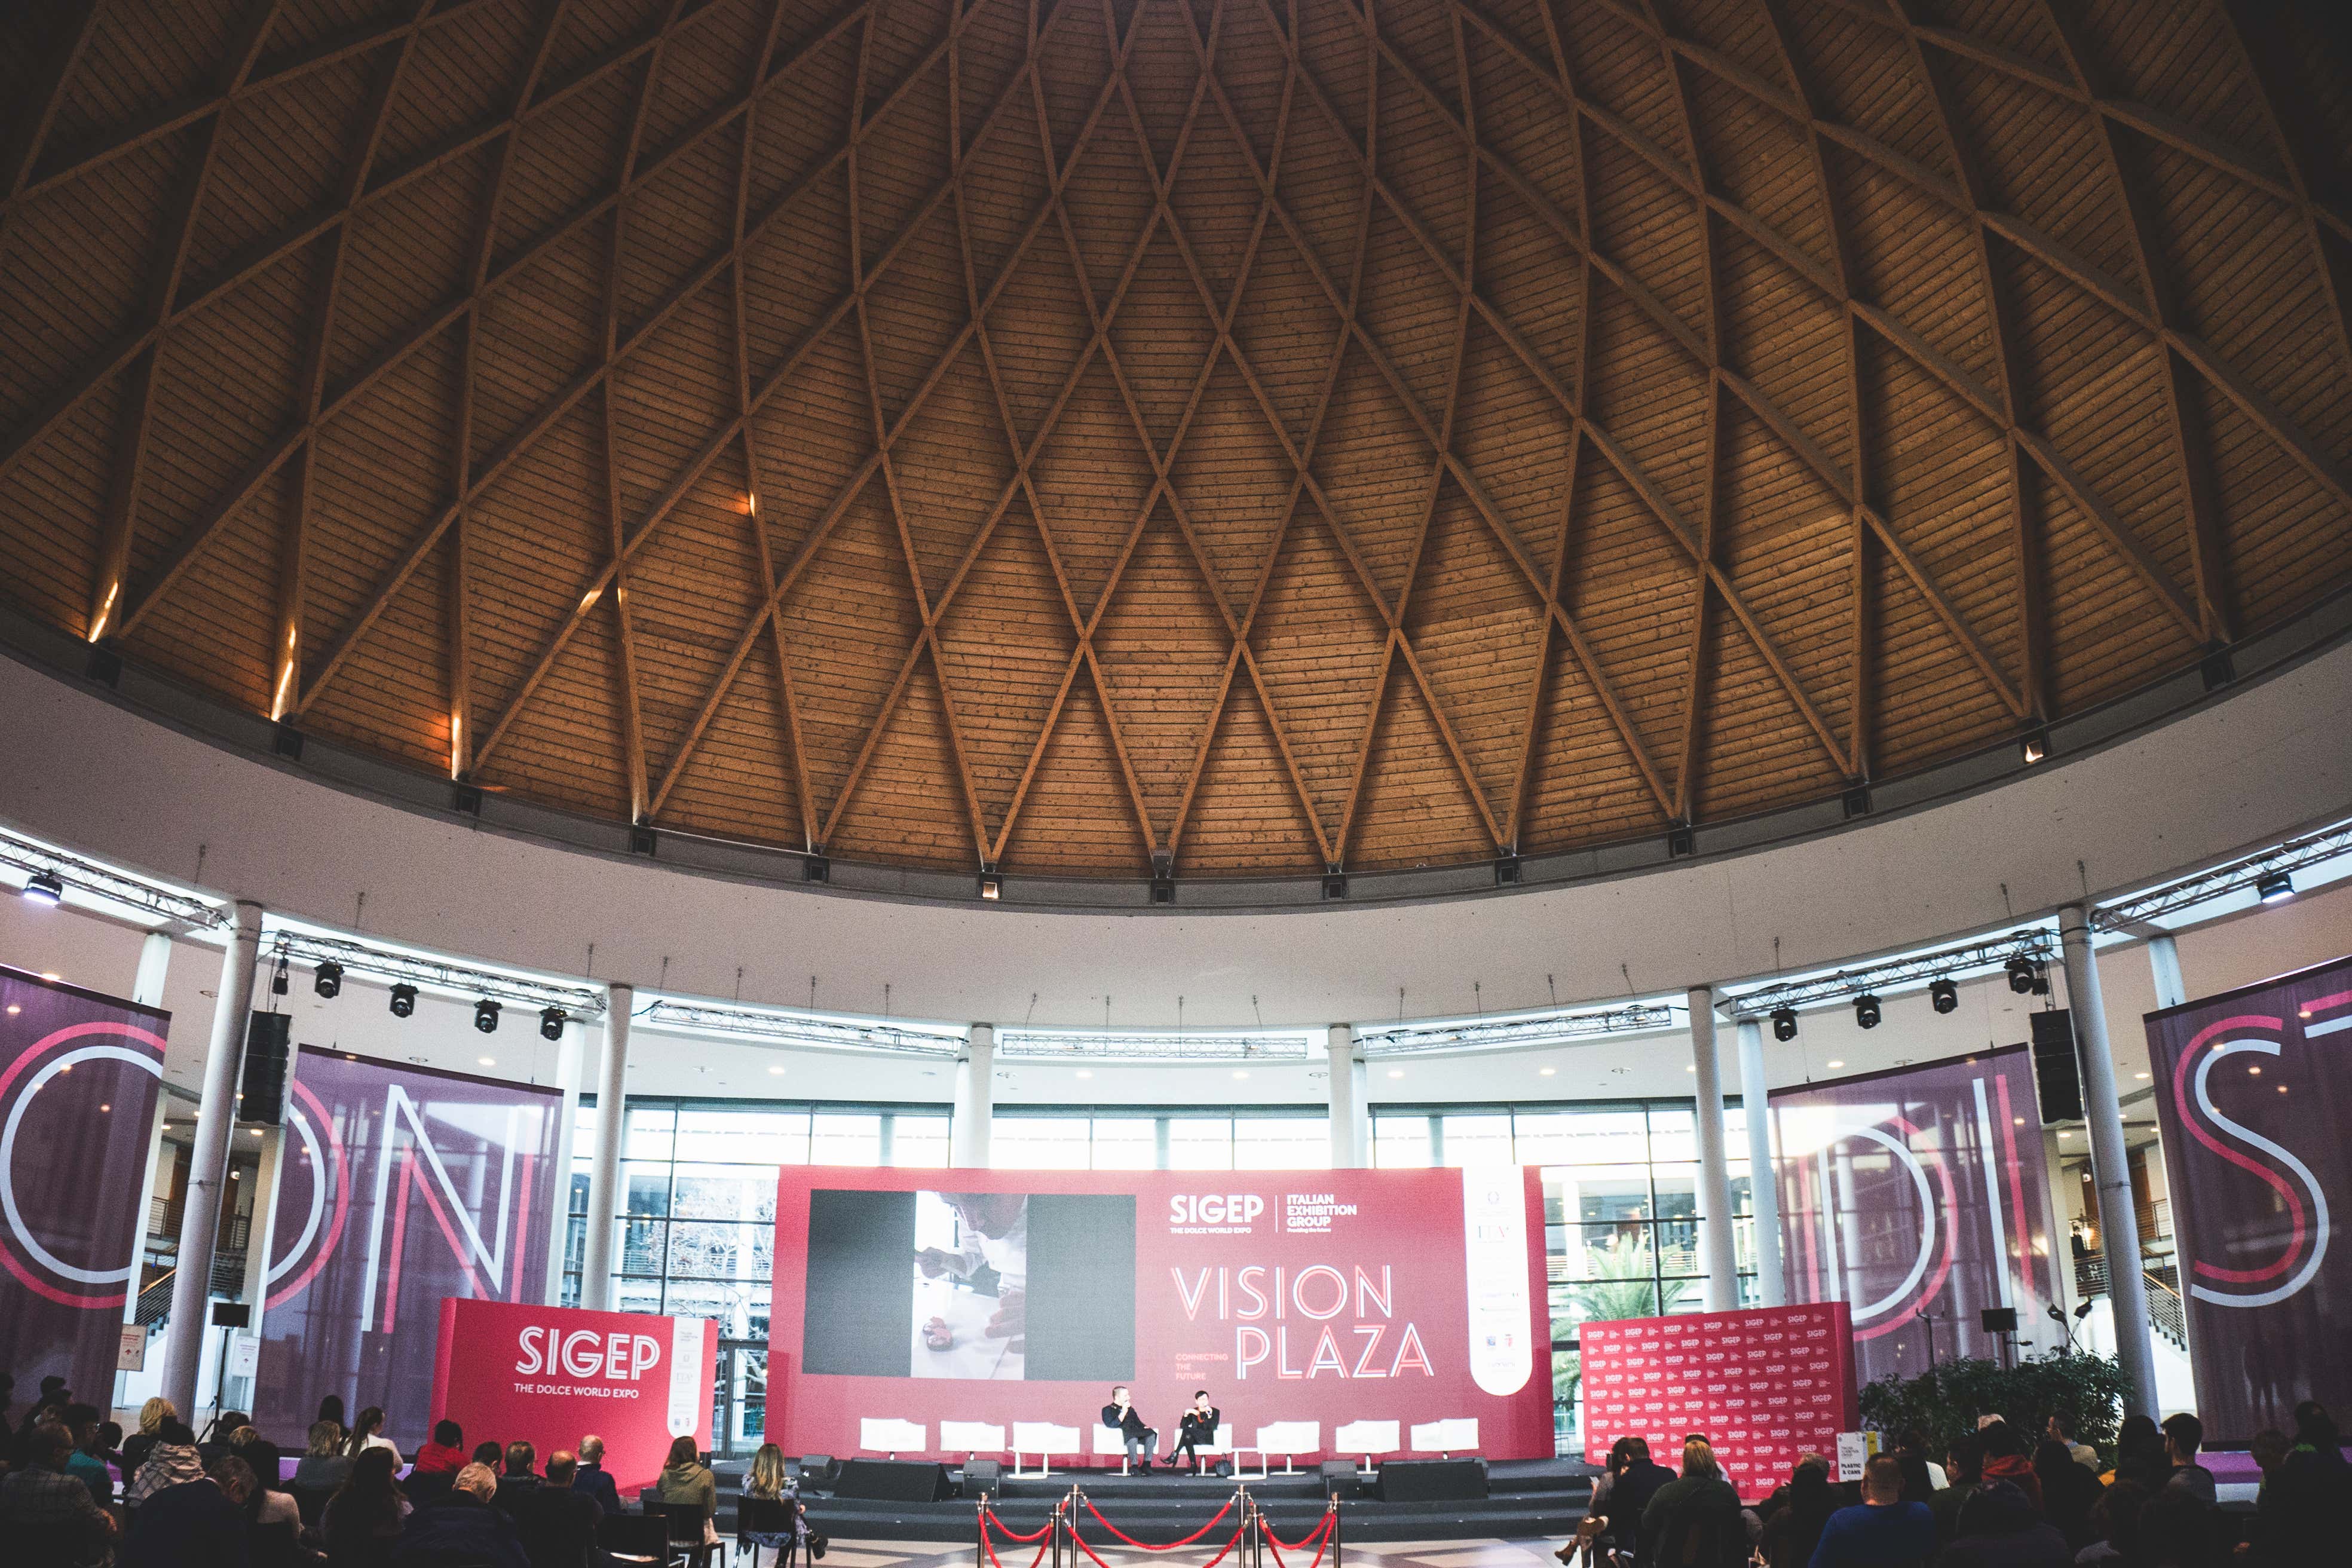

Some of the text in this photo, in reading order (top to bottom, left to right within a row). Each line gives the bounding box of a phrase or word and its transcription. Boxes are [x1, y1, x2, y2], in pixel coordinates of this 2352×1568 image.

[1287, 1194, 1334, 1205] ITALIAN
[1170, 1195, 1264, 1224] SIGEP
[1287, 1205, 1357, 1215] EXHIBITION
[1287, 1216, 1331, 1227] GROUP
[1171, 1264, 1392, 1321] VISION
[1704, 1321, 1723, 1330] SIGEP
[1745, 1318, 1764, 1327] SIGEP
[1625, 1328, 1643, 1336] SIGEP
[1664, 1324, 1682, 1333] SIGEP
[1587, 1330, 1605, 1339] SIGEP
[1807, 1329, 1827, 1337] SIGEP
[1642, 1342, 1660, 1350] SIGEP
[1682, 1339, 1700, 1347] SIGEP
[1236, 1322, 1434, 1380] PLAZA
[1604, 1344, 1621, 1352] SIGEP
[515, 1326, 660, 1380] SIGEP
[1706, 1352, 1725, 1361] SIGEP
[1747, 1350, 1766, 1358] SIGEP
[1627, 1358, 1644, 1366] SIGEP
[1665, 1355, 1684, 1364] SIGEP
[1589, 1360, 1606, 1368] SIGEP
[1810, 1361, 1829, 1370] SIGEP
[1724, 1367, 1743, 1376] SIGEP
[1766, 1364, 1786, 1373] SIGEP
[1605, 1374, 1623, 1382] SIGEP
[1643, 1372, 1662, 1380] SIGEP
[1683, 1370, 1702, 1378] SIGEP
[1667, 1386, 1686, 1394] SIGEP
[1708, 1384, 1727, 1392] SIGEP
[1750, 1382, 1769, 1390] SIGEP
[514, 1383, 639, 1398] THE DOLCE WORLD EXPO
[1591, 1390, 1608, 1398] SIGEP
[1628, 1388, 1646, 1396] SIGEP
[1645, 1402, 1664, 1410] SIGEP
[1685, 1401, 1704, 1409] SIGEP
[1726, 1399, 1745, 1407] SIGEP
[1607, 1404, 1625, 1413] SIGEP
[1630, 1418, 1648, 1426] SIGEP
[1669, 1417, 1688, 1425] SIGEP
[1710, 1415, 1729, 1423] SIGEP
[1592, 1420, 1609, 1428] SIGEP
[1647, 1433, 1665, 1441] SIGEP
[1728, 1430, 1747, 1438] SIGEP
[1754, 1446, 1774, 1454] SIGEP
[1730, 1462, 1749, 1471] SIGEP
[1772, 1461, 1793, 1469] SIGEP
